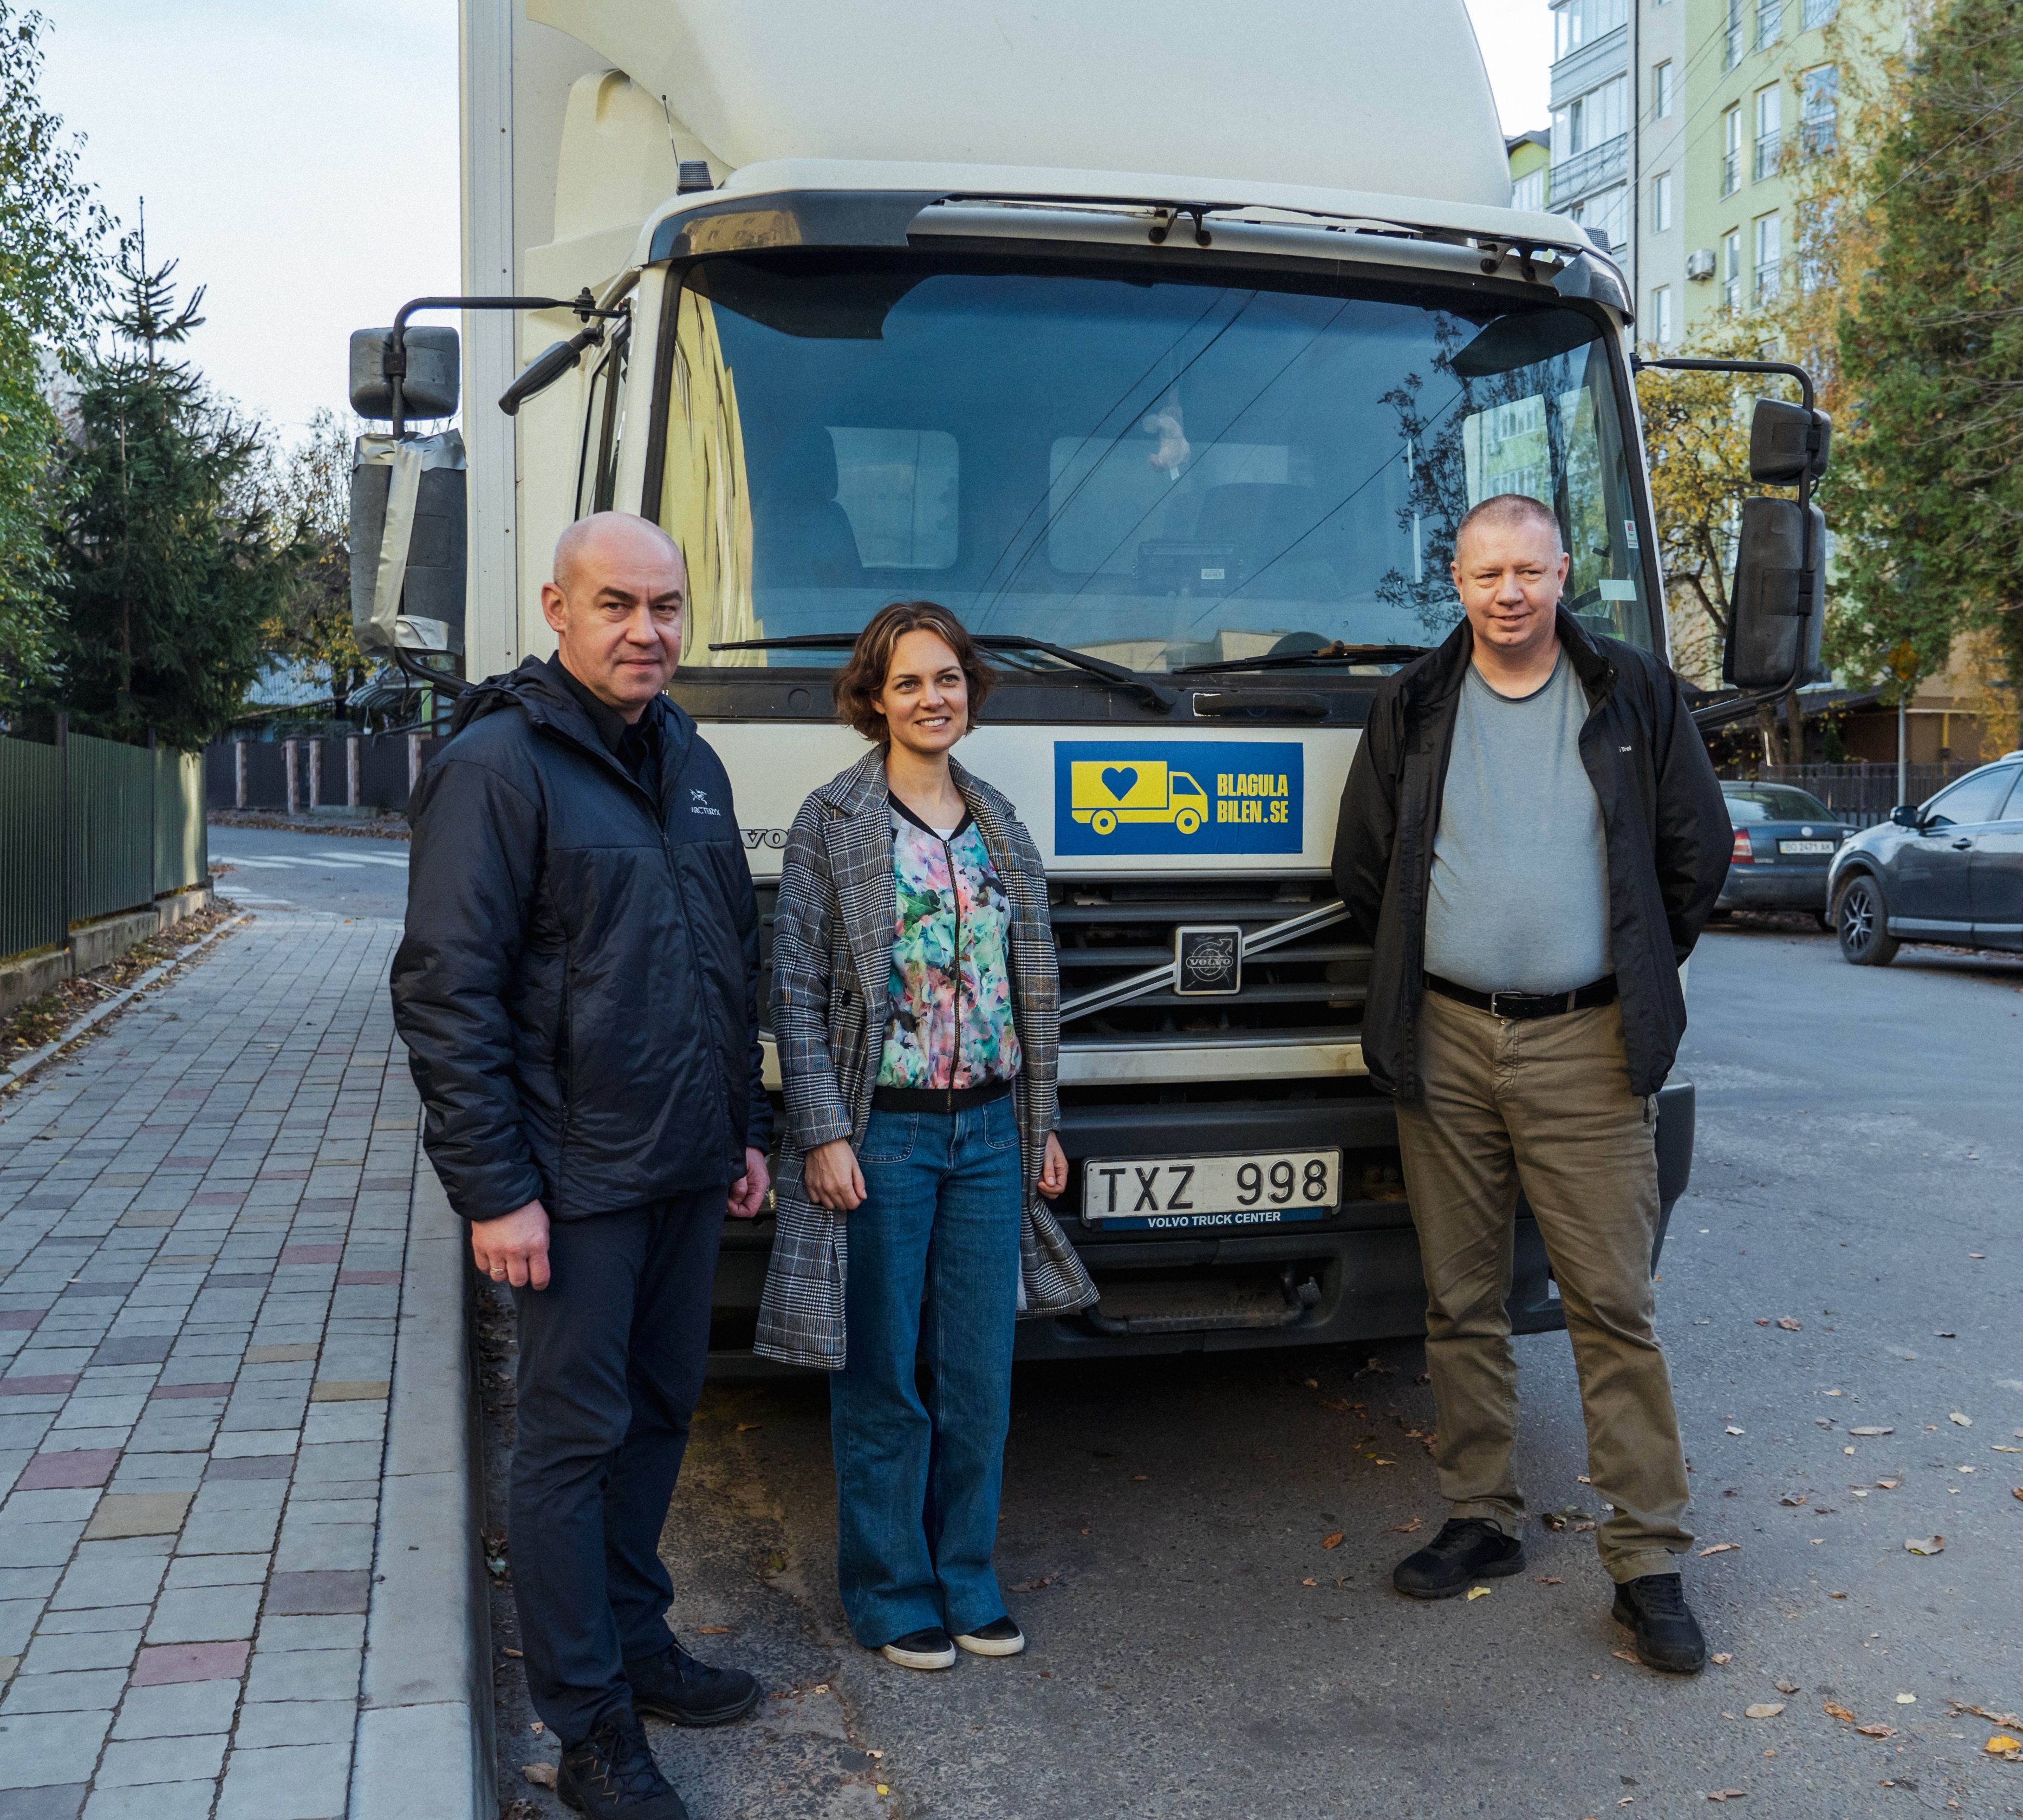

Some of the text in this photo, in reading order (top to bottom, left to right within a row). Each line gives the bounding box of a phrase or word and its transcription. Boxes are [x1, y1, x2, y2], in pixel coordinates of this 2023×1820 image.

[1217, 774, 1289, 797] BLAGULA
[1217, 800, 1289, 823] BILEN.SE
[739, 829, 790, 849] VO
[1099, 1159, 1327, 1212] TXZ 998
[1148, 1211, 1281, 1228] VOLVO TRUCK CENTER
